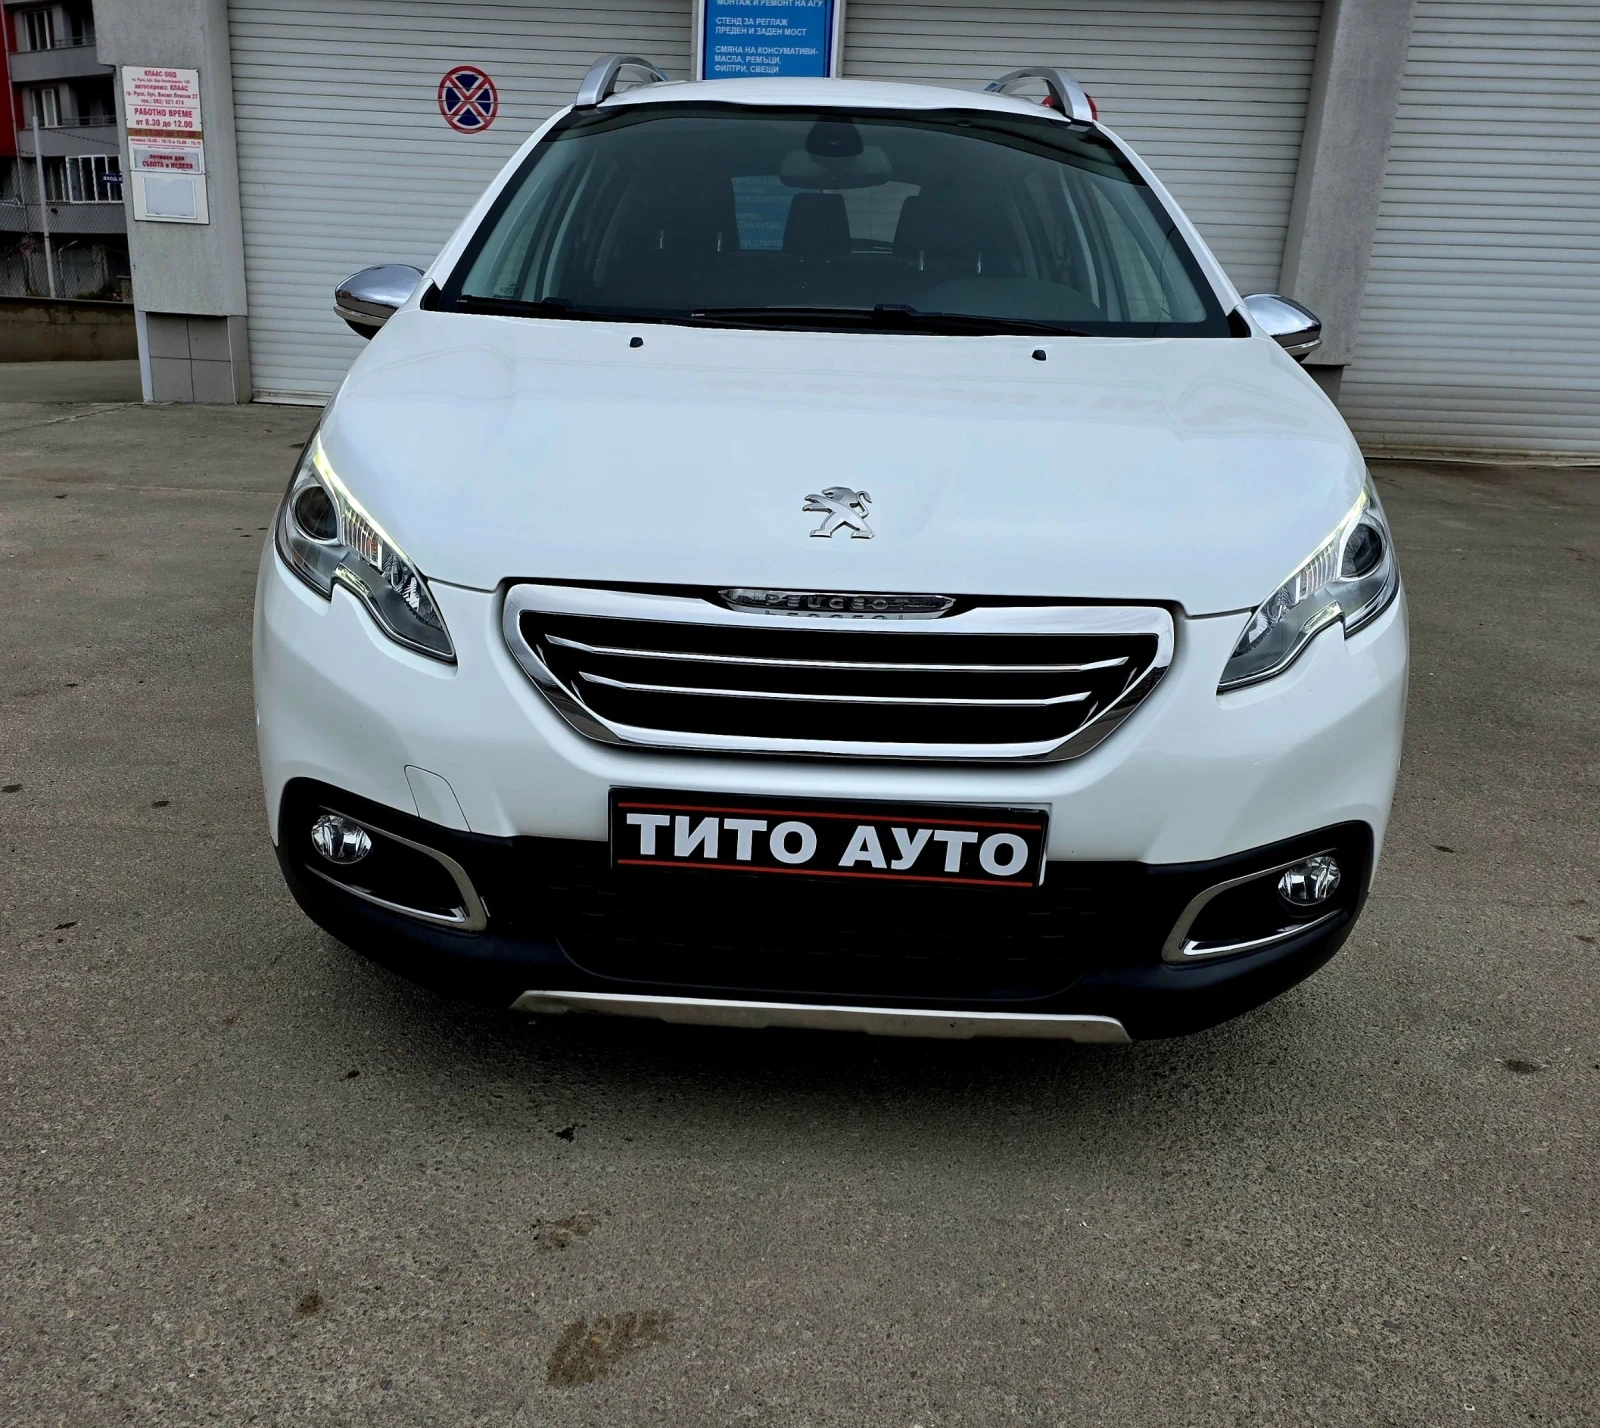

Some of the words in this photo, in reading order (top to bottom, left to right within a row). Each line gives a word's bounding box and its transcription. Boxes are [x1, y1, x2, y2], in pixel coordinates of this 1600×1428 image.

[756, 18, 788, 26] РЕГЛАЖ
[715, 26, 747, 35] ПРЕДЕН
[756, 28, 782, 36] ЗАДЕН
[714, 55, 744, 64] МАСЛА,
[714, 64, 748, 73] ФИЛТРИ,
[750, 65, 779, 74] СВЕЩИ
[134, 108, 166, 117] РАБОТНО
[168, 109, 193, 118] ВРЕМЕ
[144, 119, 160, 127] 8.30
[174, 120, 193, 128] 12.00
[765, 594, 910, 610] PEUGEOT
[626, 812, 818, 865] ТИТО
[838, 825, 1029, 876] АУТО
